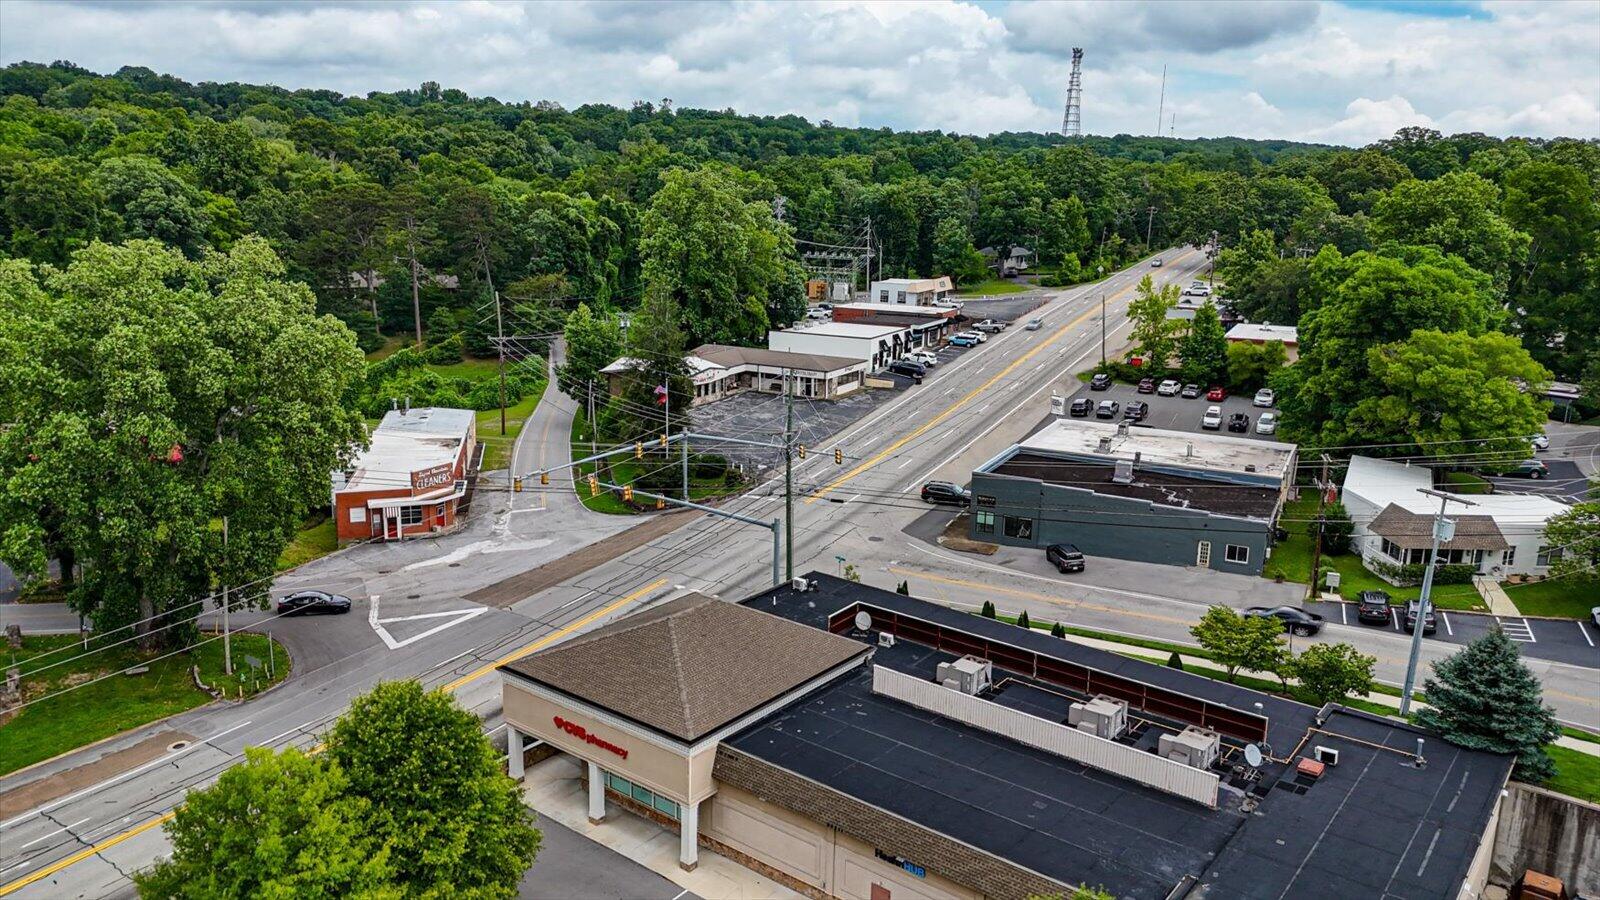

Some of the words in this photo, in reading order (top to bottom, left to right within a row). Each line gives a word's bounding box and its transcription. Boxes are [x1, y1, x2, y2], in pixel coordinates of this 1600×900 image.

[416, 471, 451, 490] CLEANERS
[563, 720, 587, 740] CVS
[586, 733, 628, 760] pharmacy
